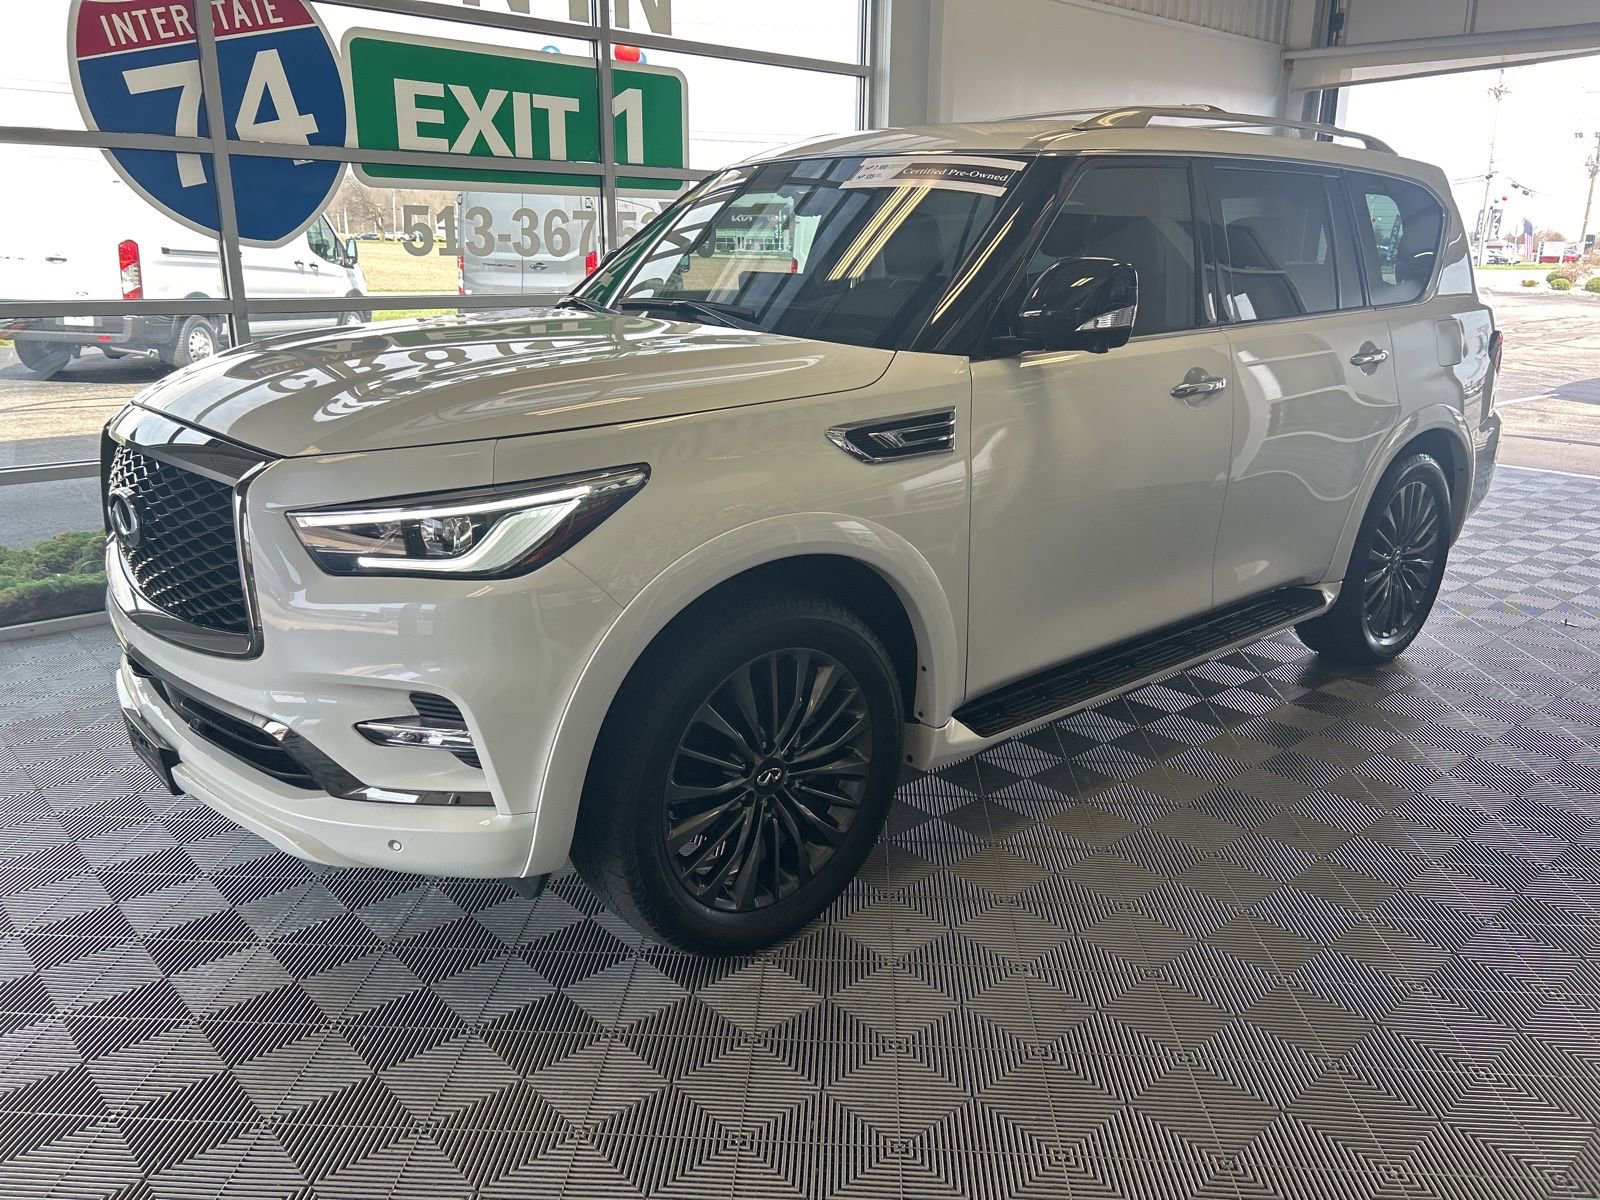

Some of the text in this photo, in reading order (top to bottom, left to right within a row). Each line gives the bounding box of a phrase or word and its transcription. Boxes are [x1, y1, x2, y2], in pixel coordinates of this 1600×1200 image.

[100, 0, 284, 47] INTERTATE
[122, 48, 319, 188] 74
[393, 78, 644, 164] EXIT 1
[902, 167, 1008, 181] Certified Pre-Owned
